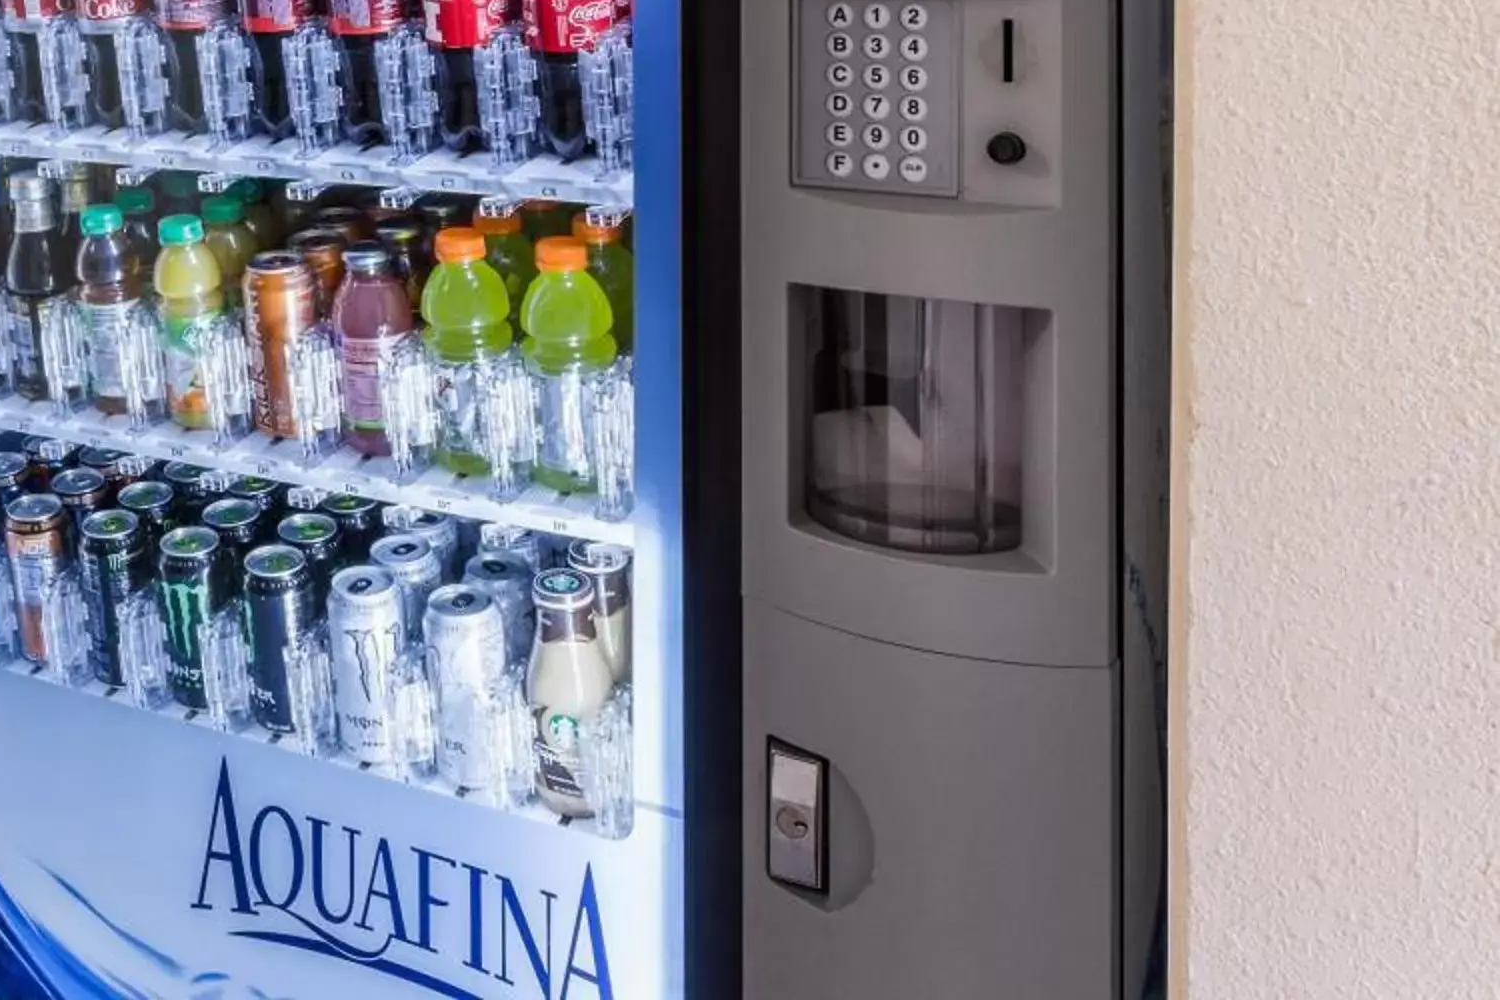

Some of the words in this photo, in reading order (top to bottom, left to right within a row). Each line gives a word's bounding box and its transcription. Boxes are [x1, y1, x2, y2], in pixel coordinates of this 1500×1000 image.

[833, 7, 847, 22] A
[872, 8, 879, 22] 1
[908, 9, 919, 24] 2
[834, 37, 846, 51] B
[871, 38, 882, 52] 3
[907, 39, 919, 54] 4
[833, 67, 847, 82] C
[871, 68, 882, 82] 5
[908, 70, 919, 84] 6
[834, 97, 847, 111] D
[871, 98, 882, 112] 7
[907, 100, 919, 114] 8
[834, 126, 845, 141] E
[871, 128, 882, 142] 9
[908, 130, 919, 145] 0
[834, 156, 846, 170] F
[190, 754, 615, 1000] AQUAFINA
